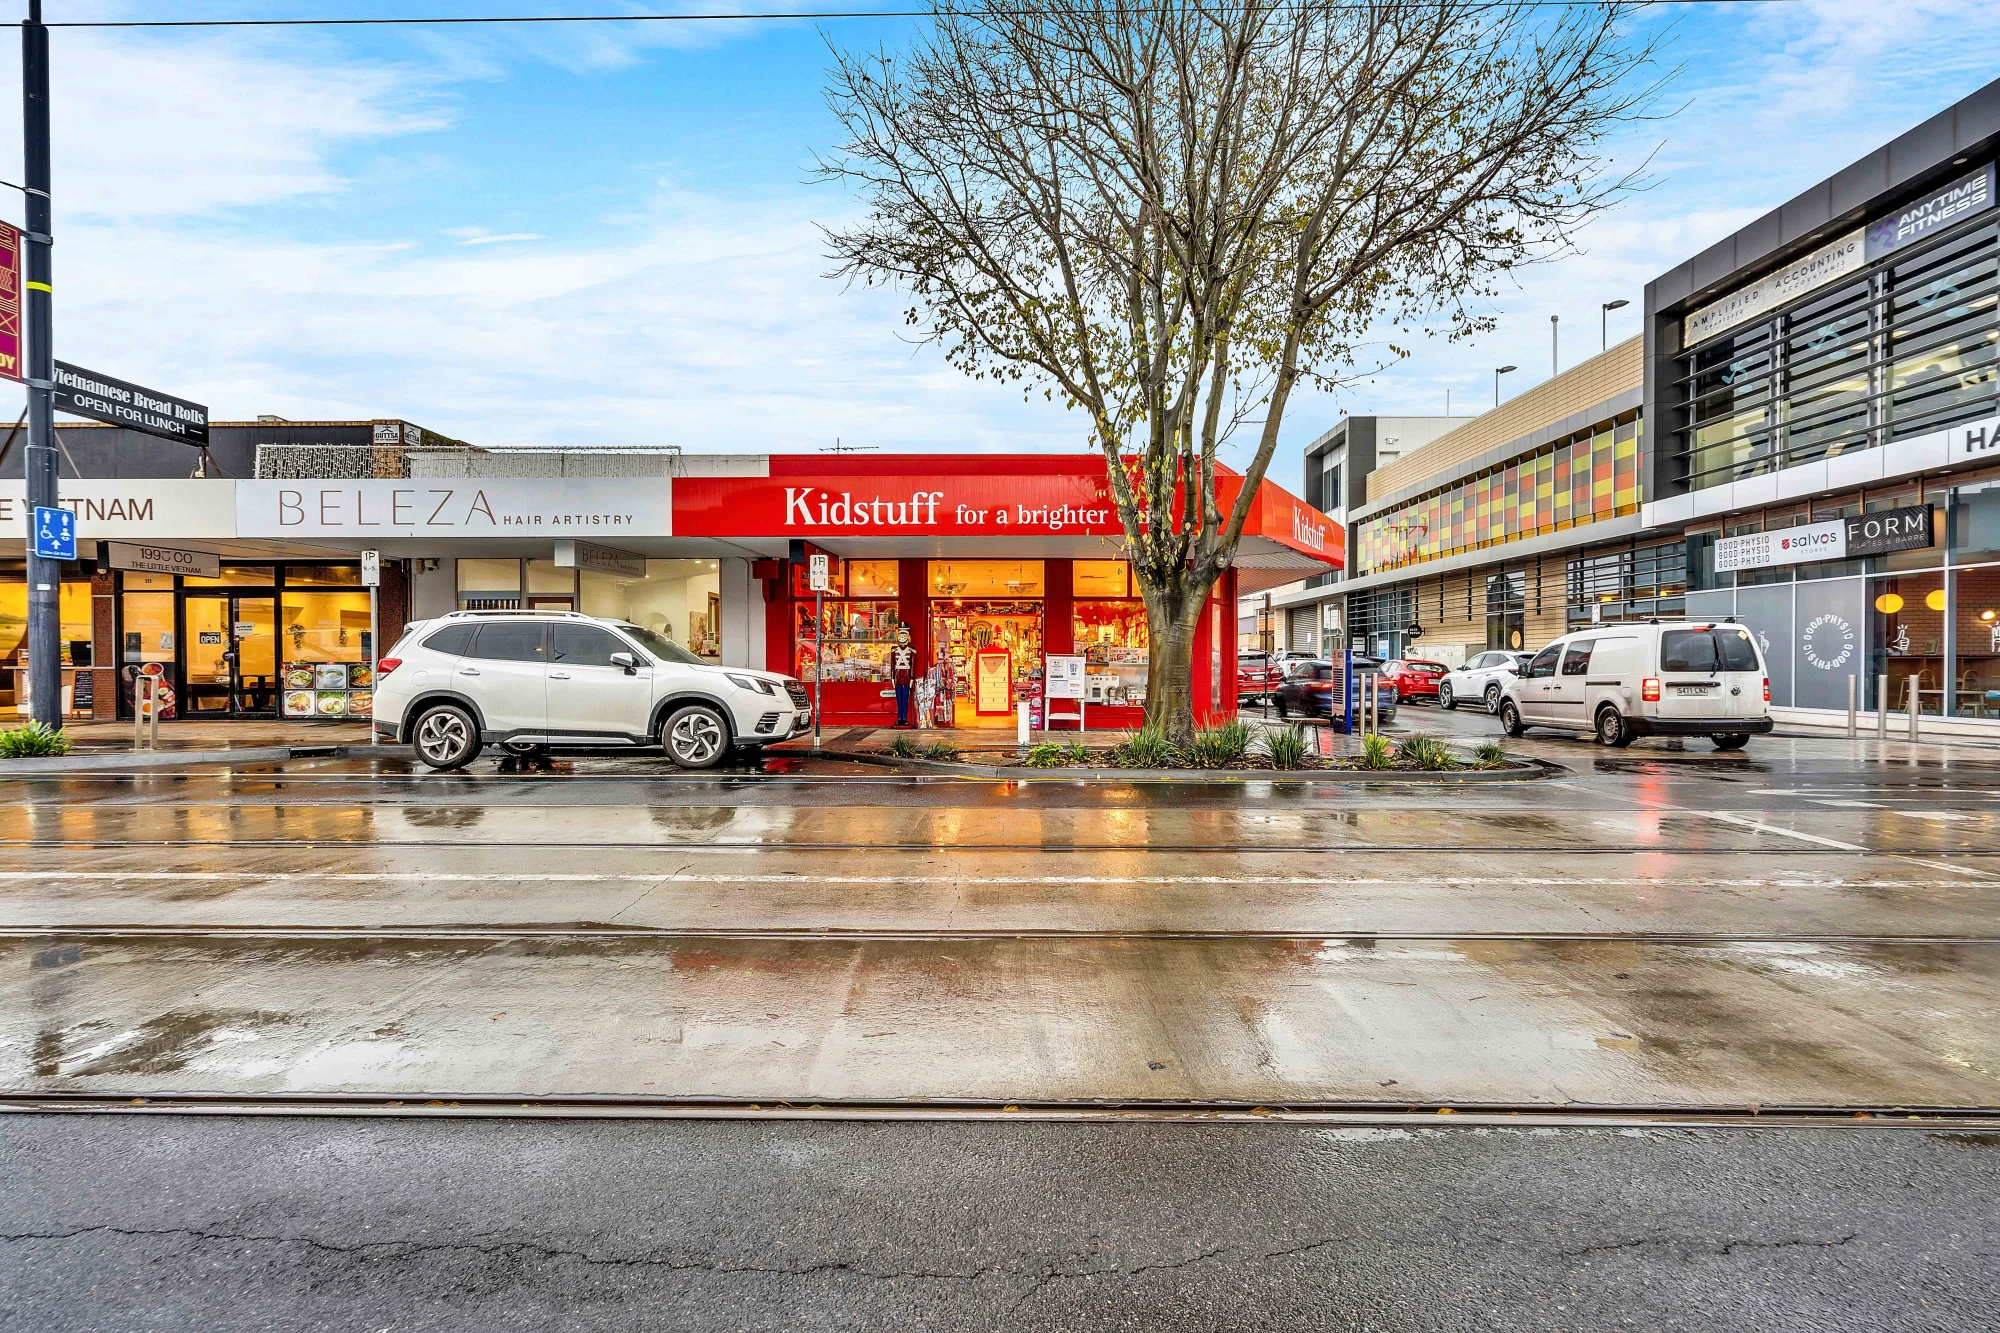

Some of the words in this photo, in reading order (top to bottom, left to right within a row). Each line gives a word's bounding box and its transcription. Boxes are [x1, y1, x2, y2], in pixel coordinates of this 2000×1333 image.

[1897, 188, 1987, 240] FITNESS
[1898, 173, 1987, 227] ANYTIME
[1692, 291, 1759, 329] AMPLIFIED
[1774, 242, 1855, 290] ACCOUNTING
[1782, 260, 1845, 293] ACCOUNTANTS
[54, 368, 131, 403] Vietnamese
[133, 391, 172, 416] Bread
[175, 404, 205, 425] Rolls
[74, 394, 112, 415] OPEN
[116, 406, 142, 422] FOR
[145, 413, 185, 434] LUNCH
[278, 489, 497, 526] BELEZA
[503, 515, 542, 525] HAIR
[552, 514, 633, 525] ARTISTRY
[784, 487, 944, 525] Kidstuff
[955, 504, 988, 525] for
[995, 508, 1009, 525] a
[1016, 503, 1108, 530] brighter
[1293, 506, 1325, 552] Kidstuff
[1791, 532, 1837, 548] salvos
[1848, 513, 1923, 541] FORM
[131, 561, 146, 569] THE
[147, 563, 170, 571] LITTLE
[171, 565, 202, 574] VIETNAM
[173, 552, 193, 564] CO
[582, 547, 620, 568] BELEZA
[1801, 546, 1828, 555] STORES
[200, 635, 220, 644] OPEN
